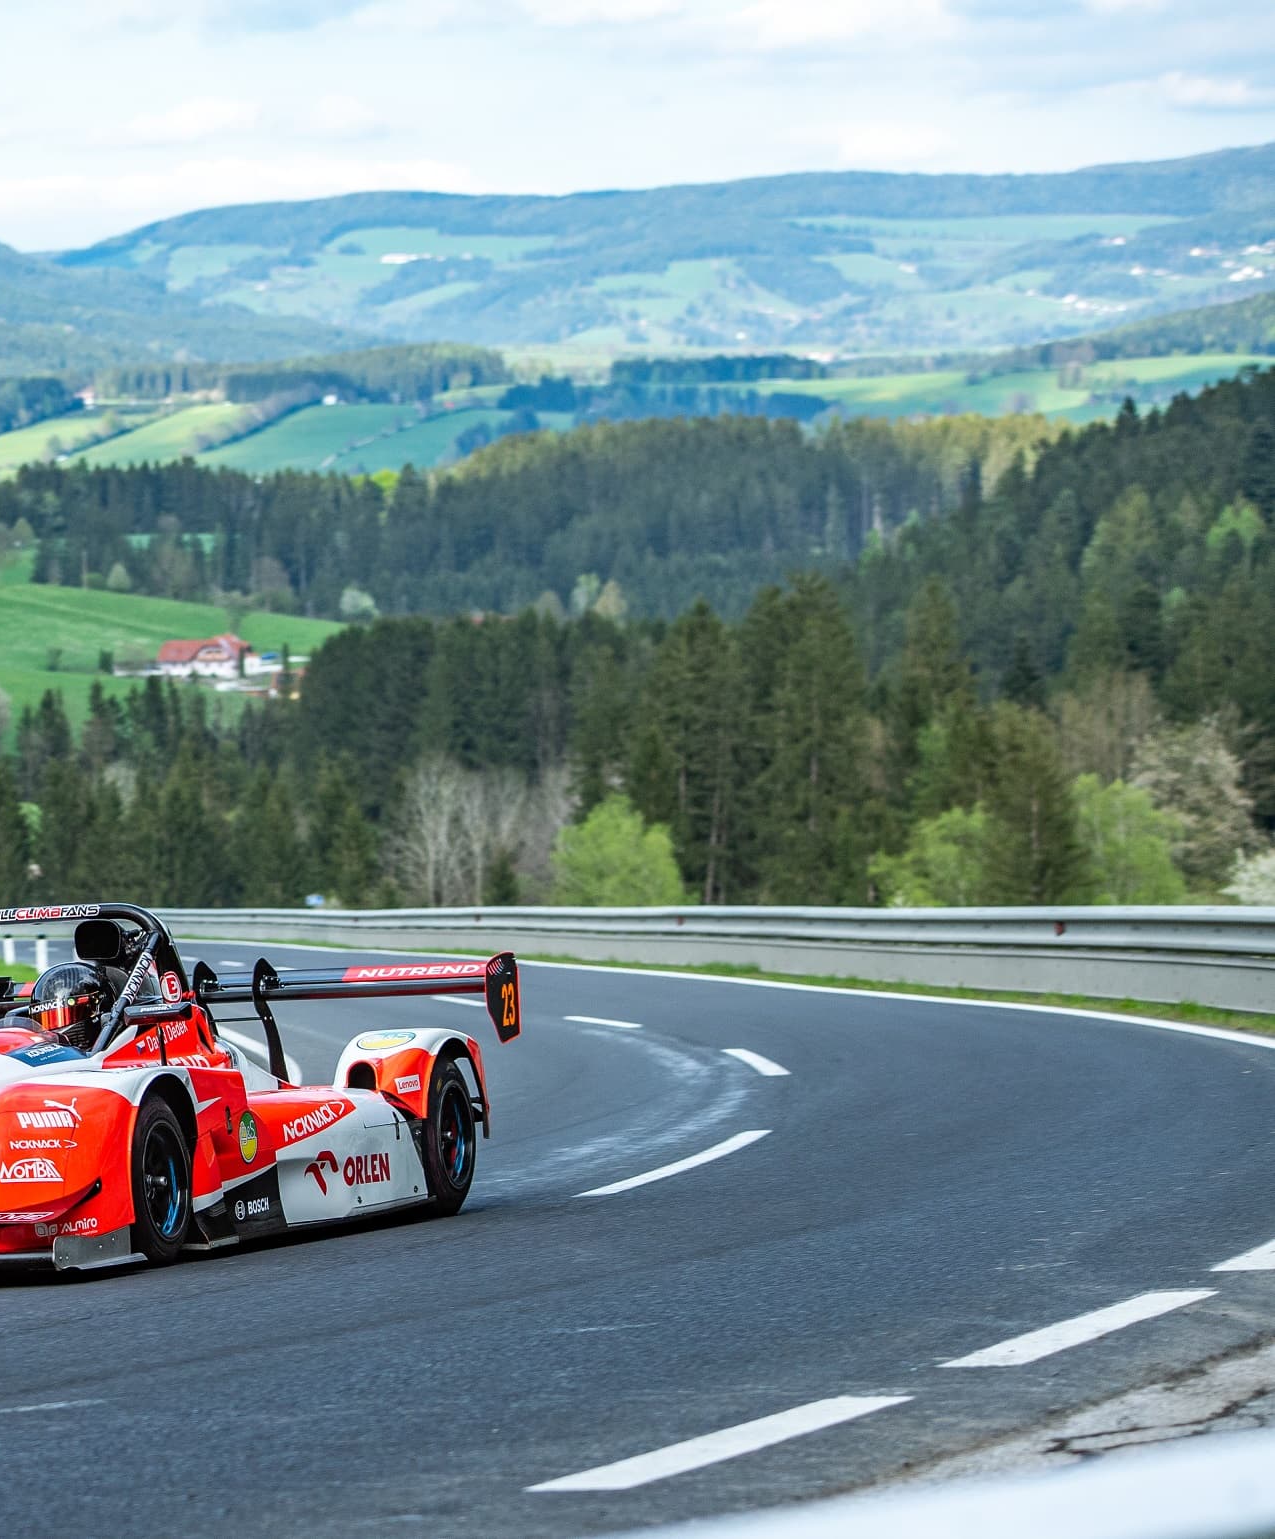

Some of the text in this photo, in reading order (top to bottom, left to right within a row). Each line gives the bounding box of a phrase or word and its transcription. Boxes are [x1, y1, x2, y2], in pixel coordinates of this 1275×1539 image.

[357, 964, 480, 978] NUTREND
[166, 977, 178, 995] E
[501, 982, 516, 1027] 23
[398, 1079, 419, 1091] Lenovo
[16, 1111, 76, 1128] PUMA
[343, 1152, 391, 1187] ORLEN
[247, 1197, 270, 1215] BOSCH
